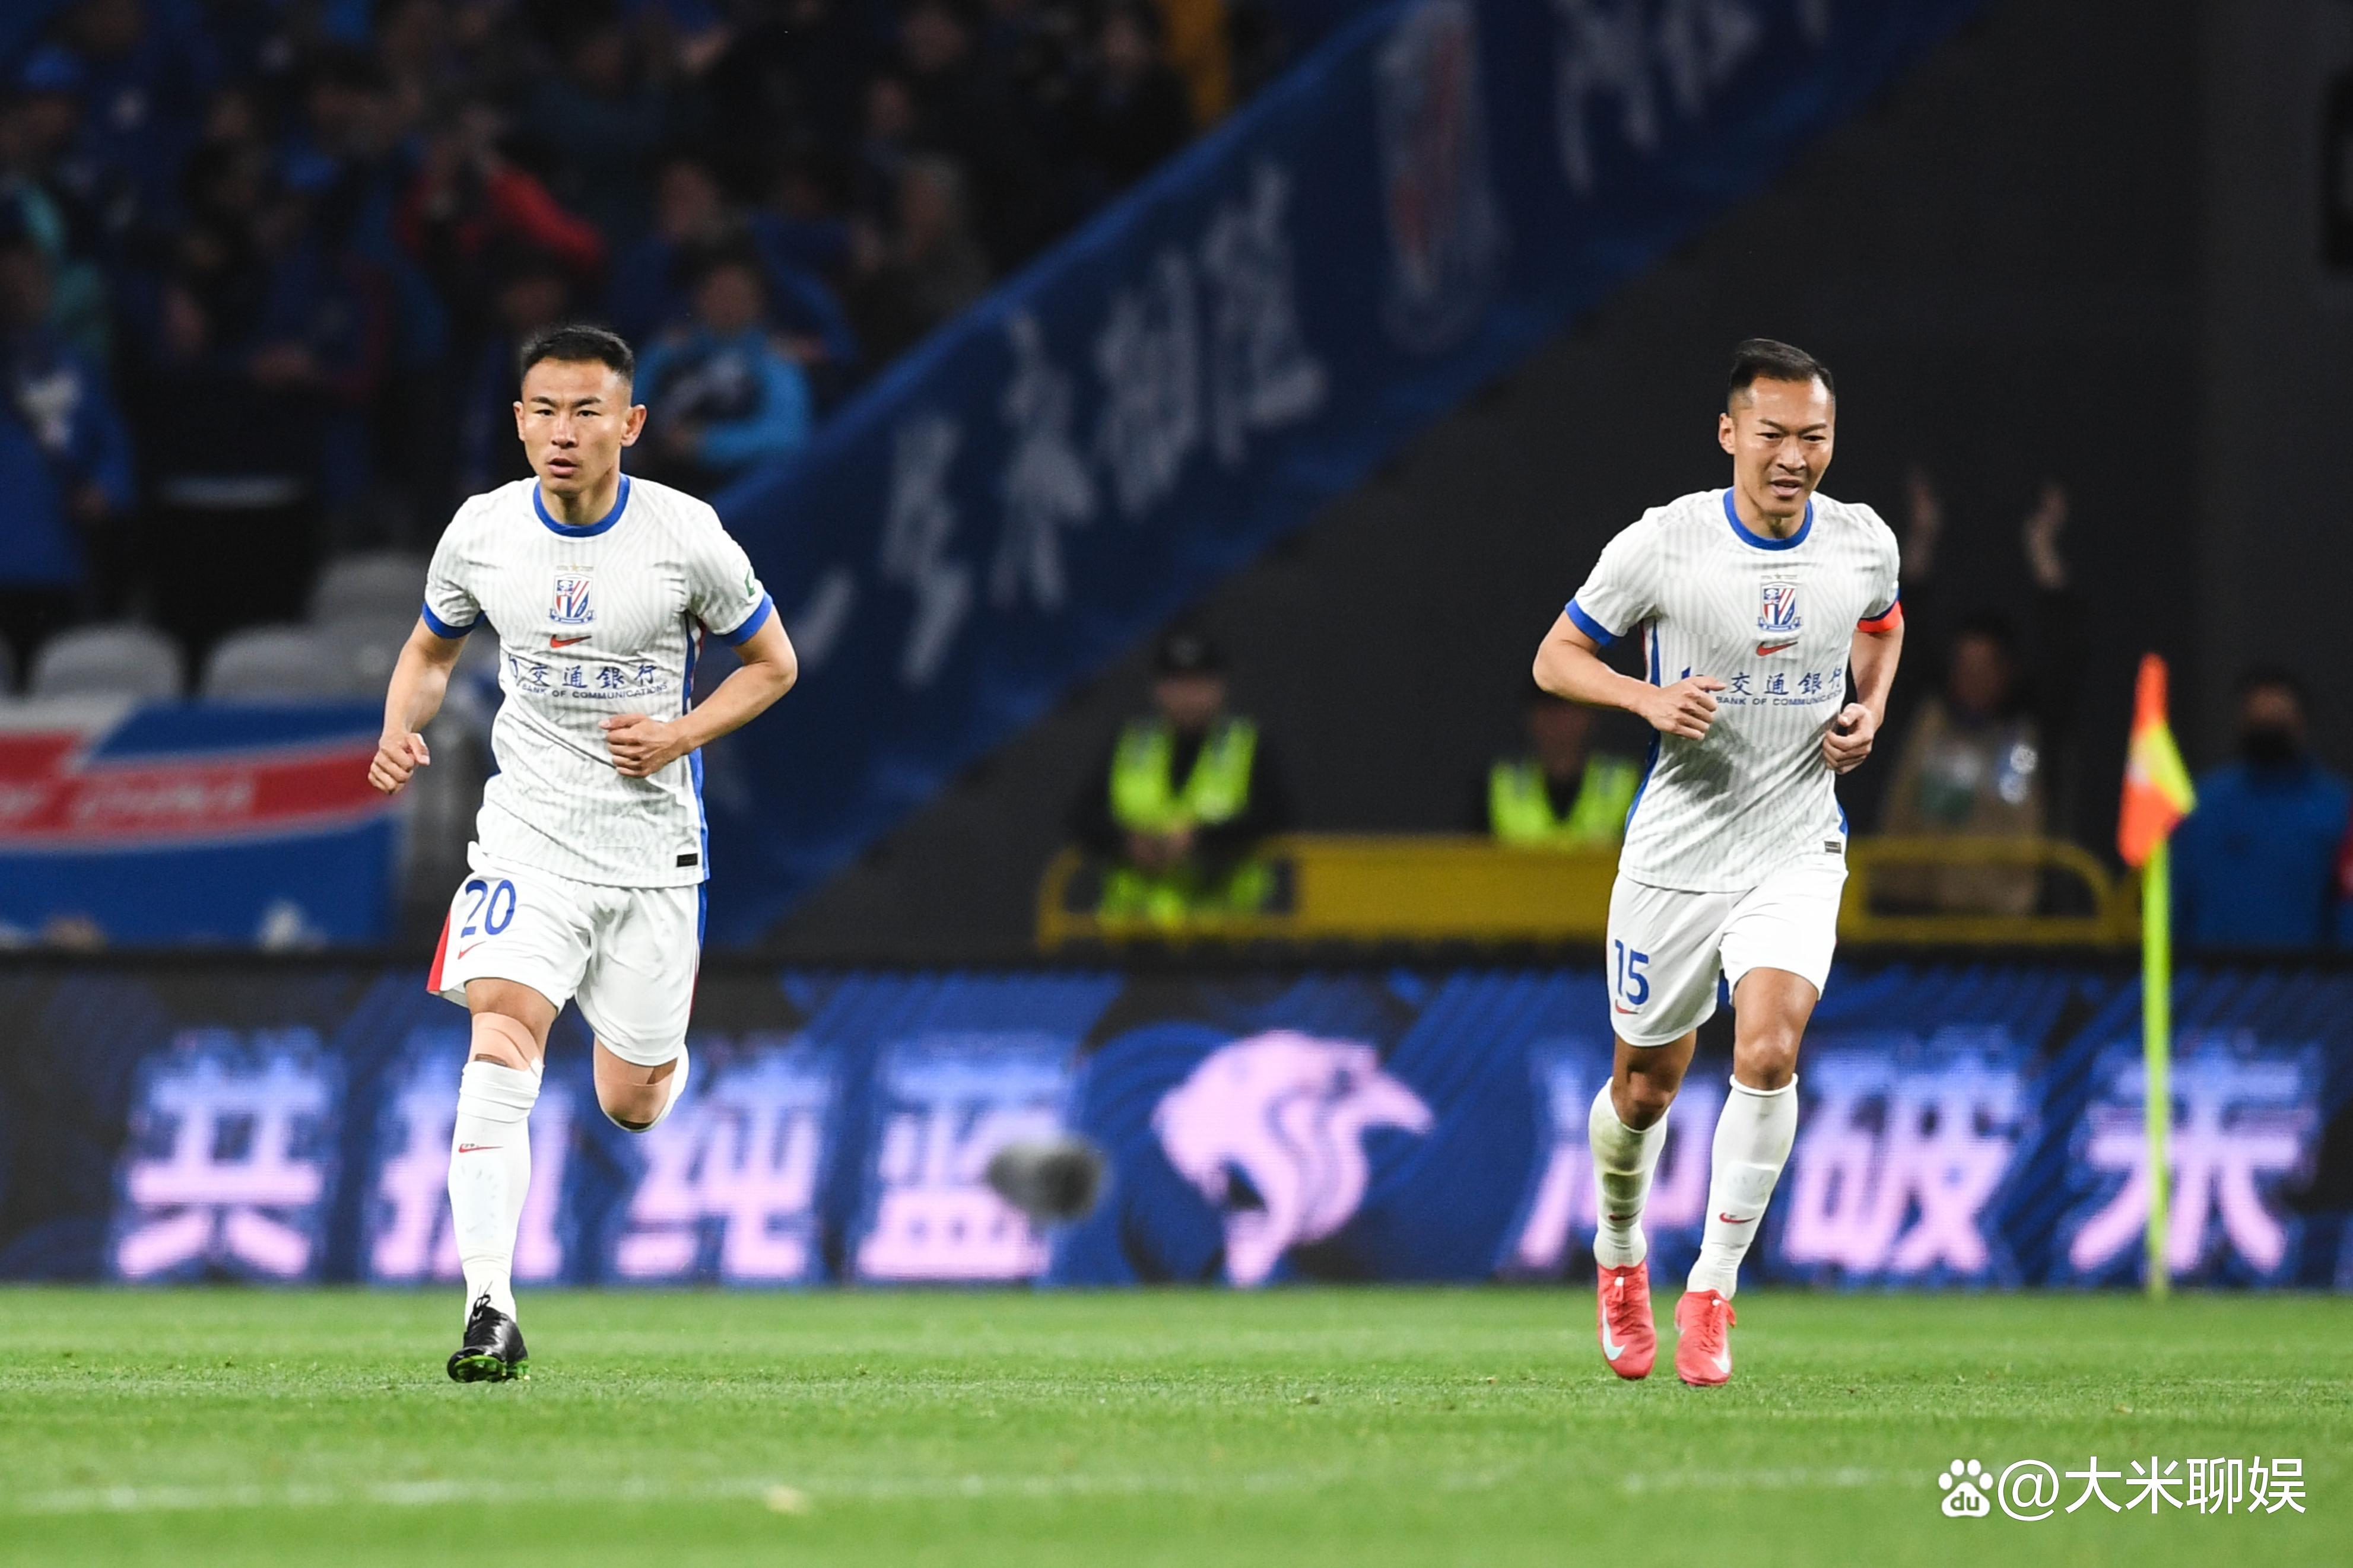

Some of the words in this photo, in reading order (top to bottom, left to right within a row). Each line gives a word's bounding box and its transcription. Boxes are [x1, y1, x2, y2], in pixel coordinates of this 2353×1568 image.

[528, 663, 658, 689] 交通銀行
[552, 689, 567, 698] OF
[571, 682, 668, 699] COMMUNICATIONS
[1716, 696, 1747, 705] BANK
[1752, 698, 1768, 706] OF
[461, 879, 517, 939] 20
[1614, 939, 1650, 1005] 15
